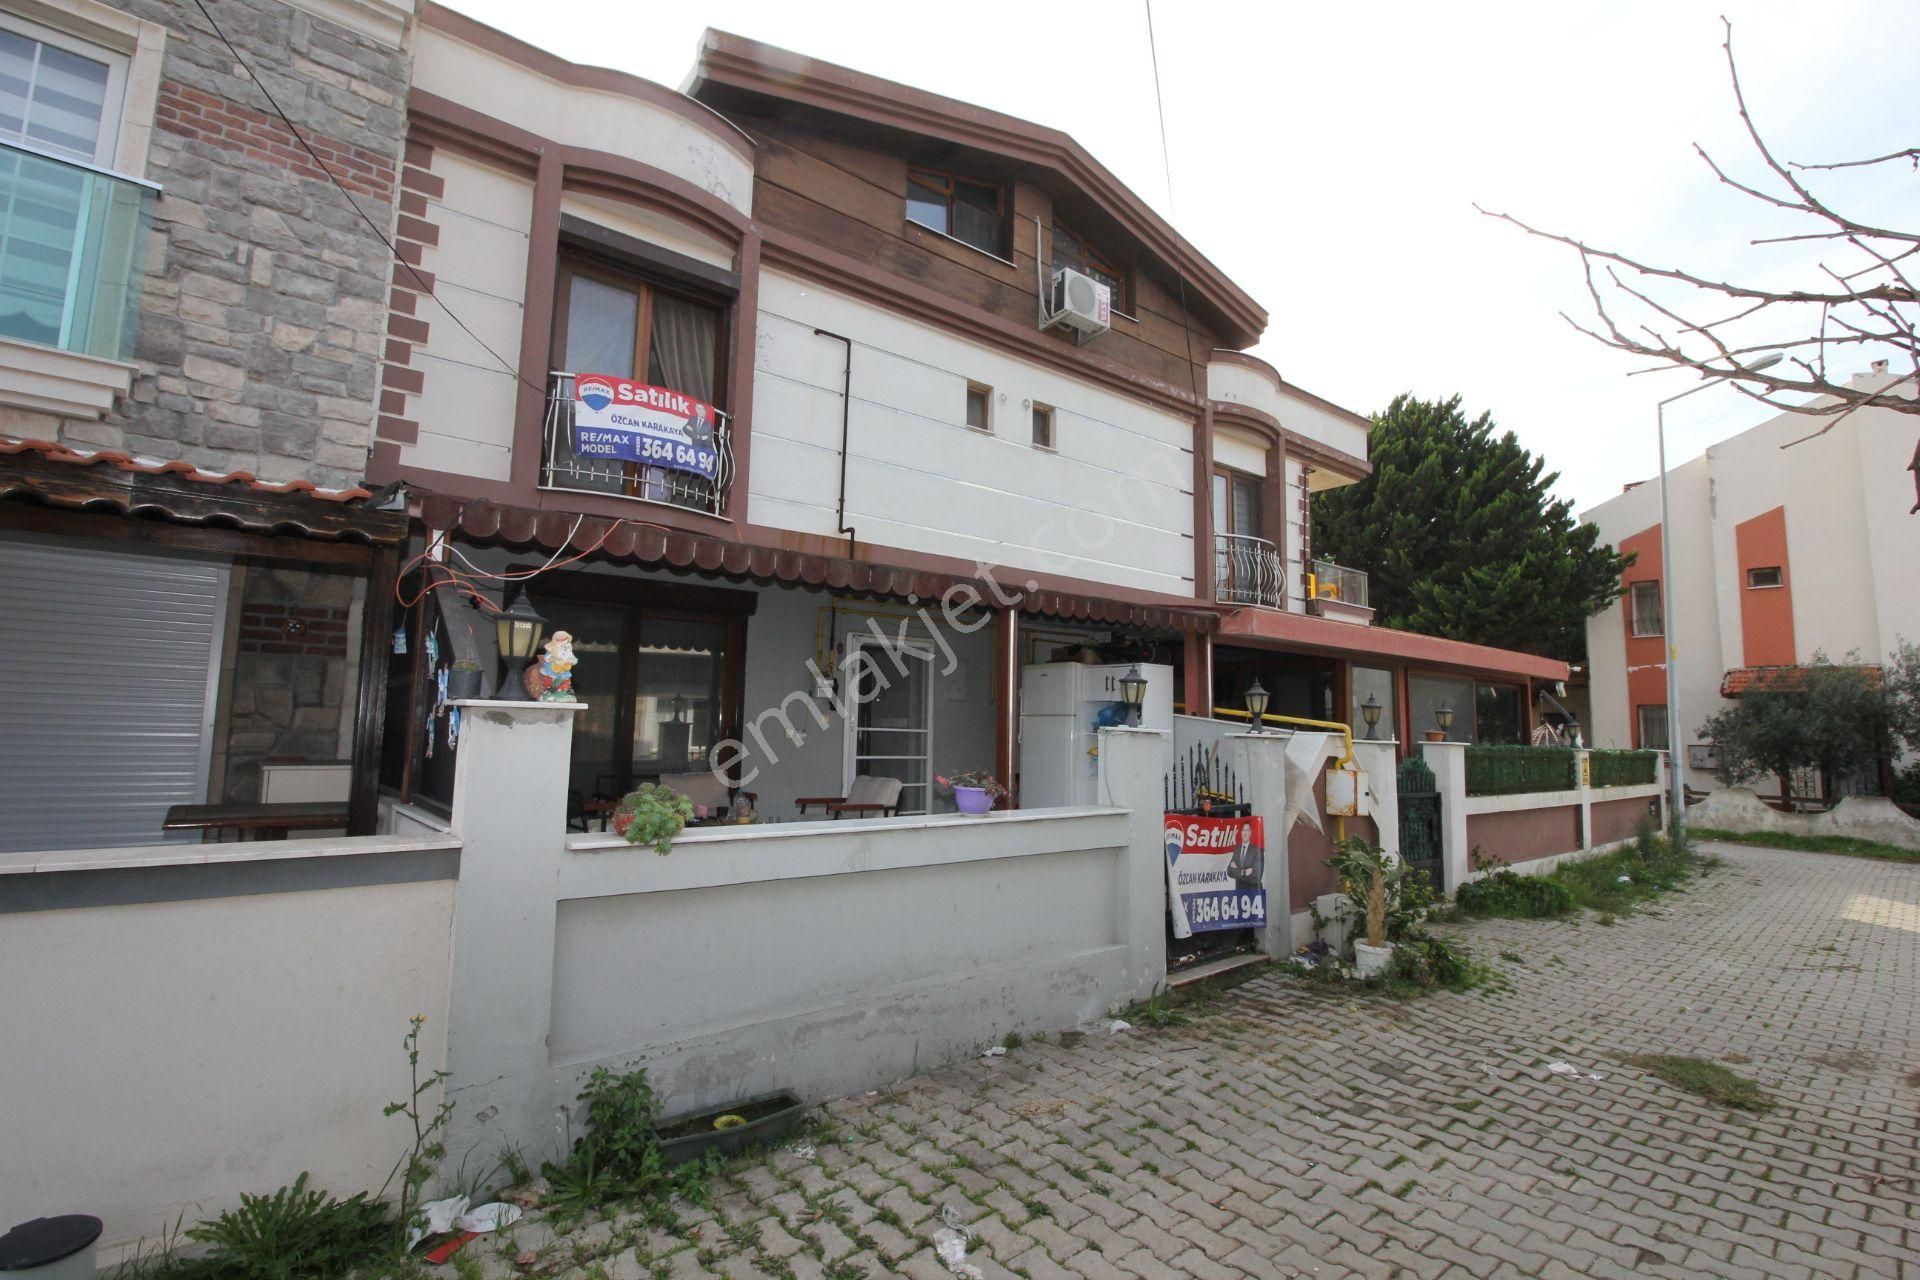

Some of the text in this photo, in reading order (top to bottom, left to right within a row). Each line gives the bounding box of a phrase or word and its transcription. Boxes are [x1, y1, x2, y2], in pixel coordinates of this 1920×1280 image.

[618, 383, 690, 415] Satılık
[611, 414, 684, 436] ÖZCAN KARAKAYA
[580, 432, 630, 445] RE/MAX
[581, 443, 617, 454] MODEL
[642, 437, 674, 461] 364
[676, 445, 697, 466] 64
[698, 451, 714, 472] 94
[1186, 824, 1238, 847] Satılık
[1178, 870, 1228, 885] ÖZCAN KARAKAYA
[1196, 896, 1220, 923] 364
[1221, 896, 1239, 919] 64
[1240, 895, 1265, 919] 94
